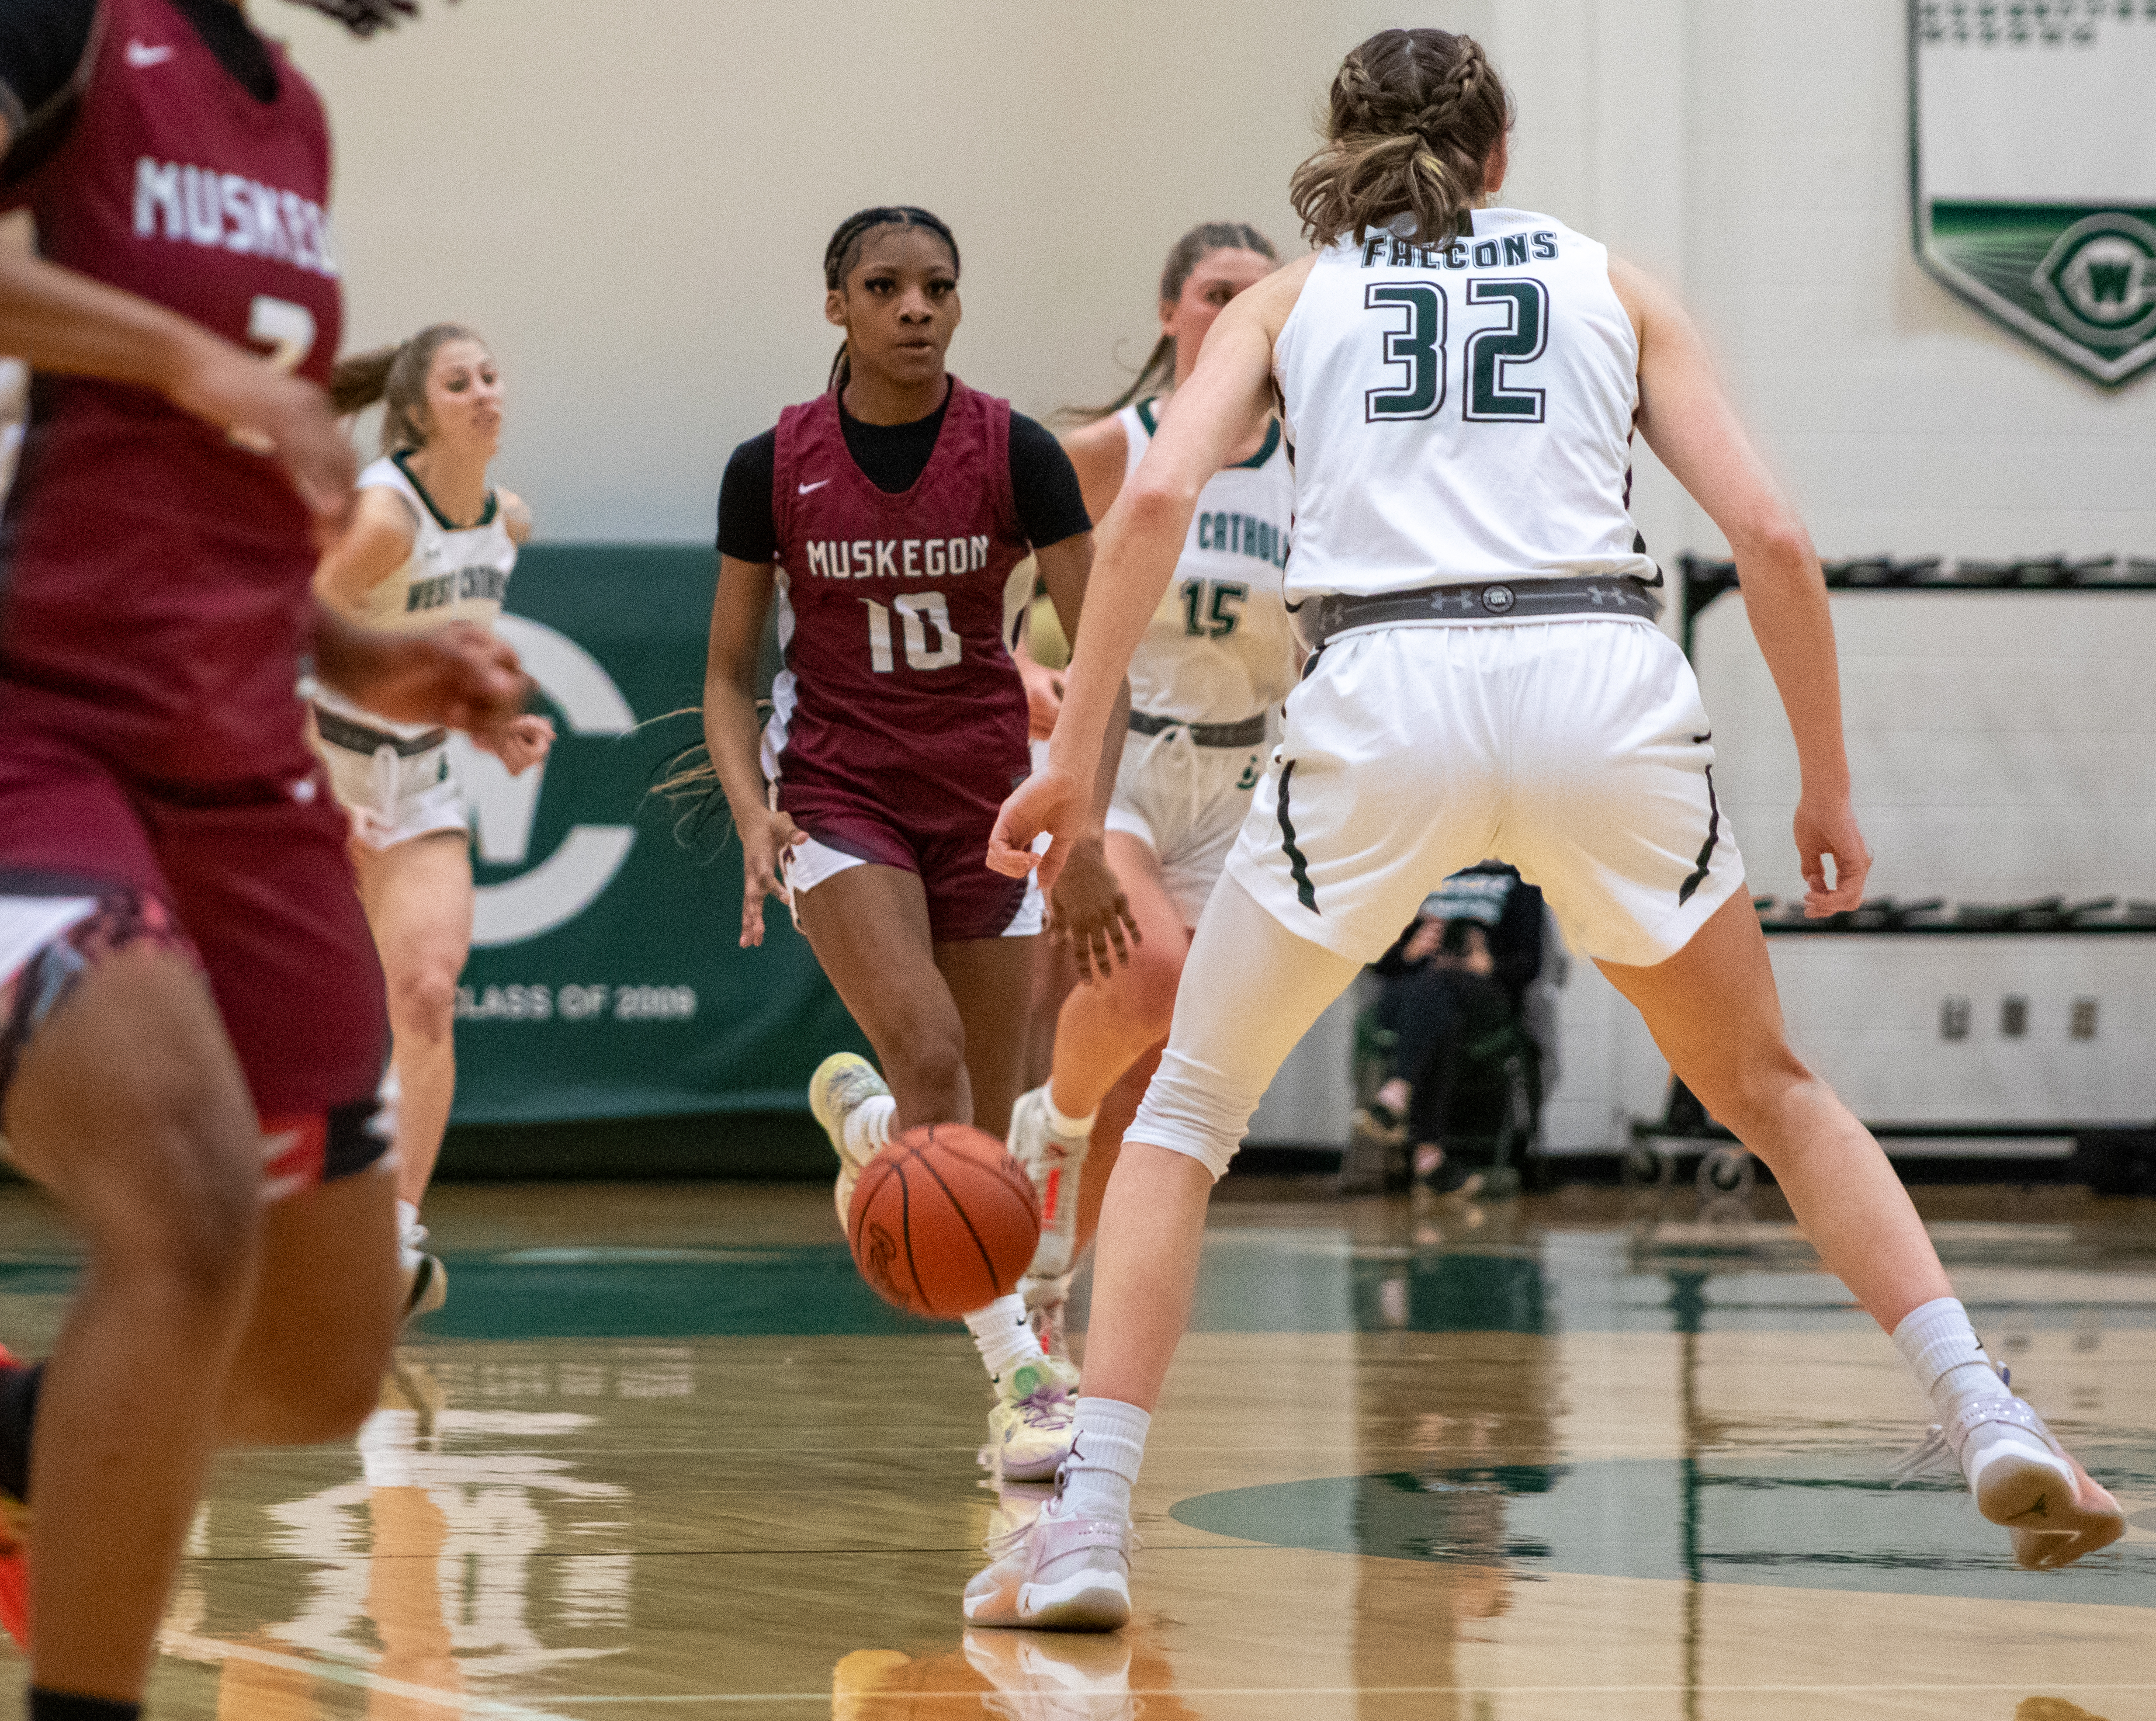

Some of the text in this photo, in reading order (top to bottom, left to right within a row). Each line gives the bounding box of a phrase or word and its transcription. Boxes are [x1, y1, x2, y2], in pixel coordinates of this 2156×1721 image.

[1360, 230, 1559, 270] FALCONS
[1364, 276, 1550, 424] 32
[806, 535, 989, 579] MUSKEGON
[858, 590, 962, 674] 10
[1180, 577, 1250, 639] 15
[557, 983, 610, 1019] OF
